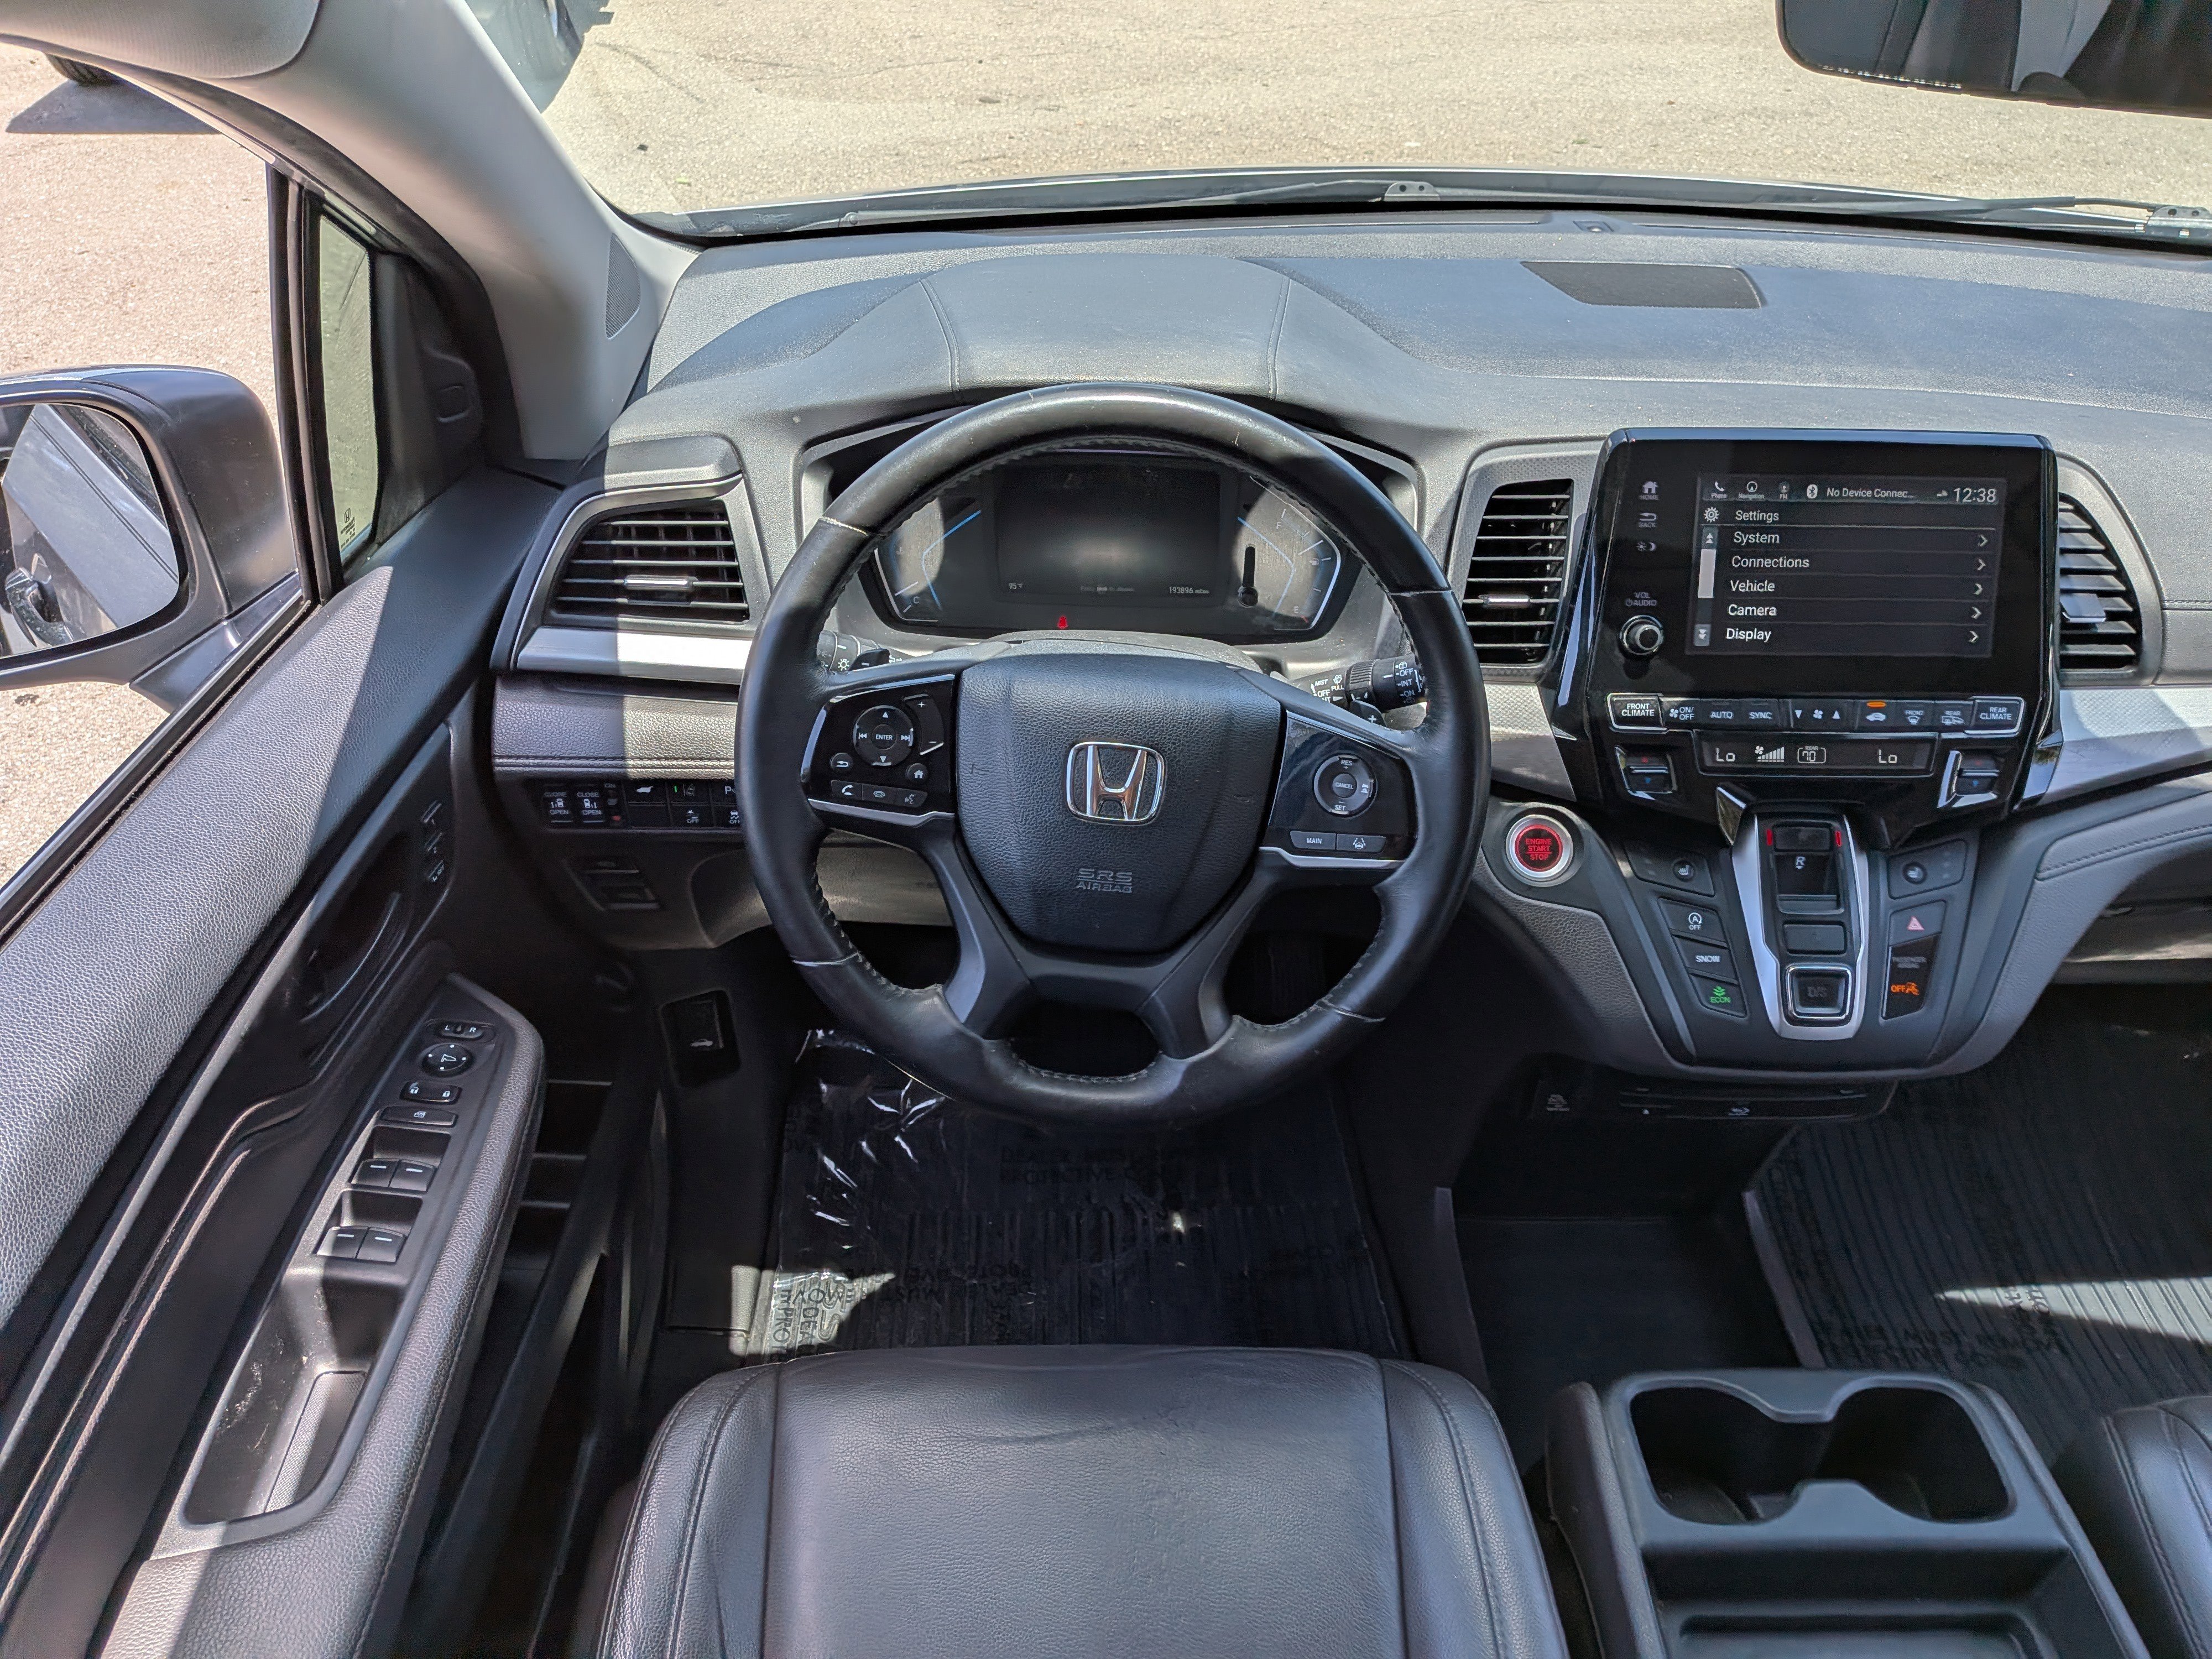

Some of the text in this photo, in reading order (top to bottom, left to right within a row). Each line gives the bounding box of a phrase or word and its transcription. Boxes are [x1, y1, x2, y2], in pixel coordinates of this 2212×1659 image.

[1827, 488, 1840, 497] No
[1842, 488, 1872, 498] Device
[1954, 488, 1997, 503] 12:38
[1735, 510, 1780, 523] Settings
[1734, 531, 1780, 546] System
[1731, 555, 1810, 568] Connections
[1730, 579, 1776, 592] Vehicle
[913, 596, 920, 604] C
[1294, 606, 1300, 614] E
[1728, 604, 1777, 617] Camera
[1726, 628, 1772, 643] Display
[1399, 668, 1413, 677] OFF
[1314, 679, 1328, 687] MIST
[1317, 689, 1331, 697] OFF
[1404, 689, 1415, 697] ON
[1621, 709, 1655, 717] CLIMATE
[1710, 711, 1734, 719] AUTO
[1749, 711, 1772, 719] SYNC
[1802, 750, 1816, 762] 70
[1334, 781, 1354, 790] CANCEL
[1078, 868, 1133, 882] SRS
[1075, 881, 1133, 894] AIRBAG
[1695, 954, 1721, 963] SNOW
[1891, 985, 1906, 993] OFF
